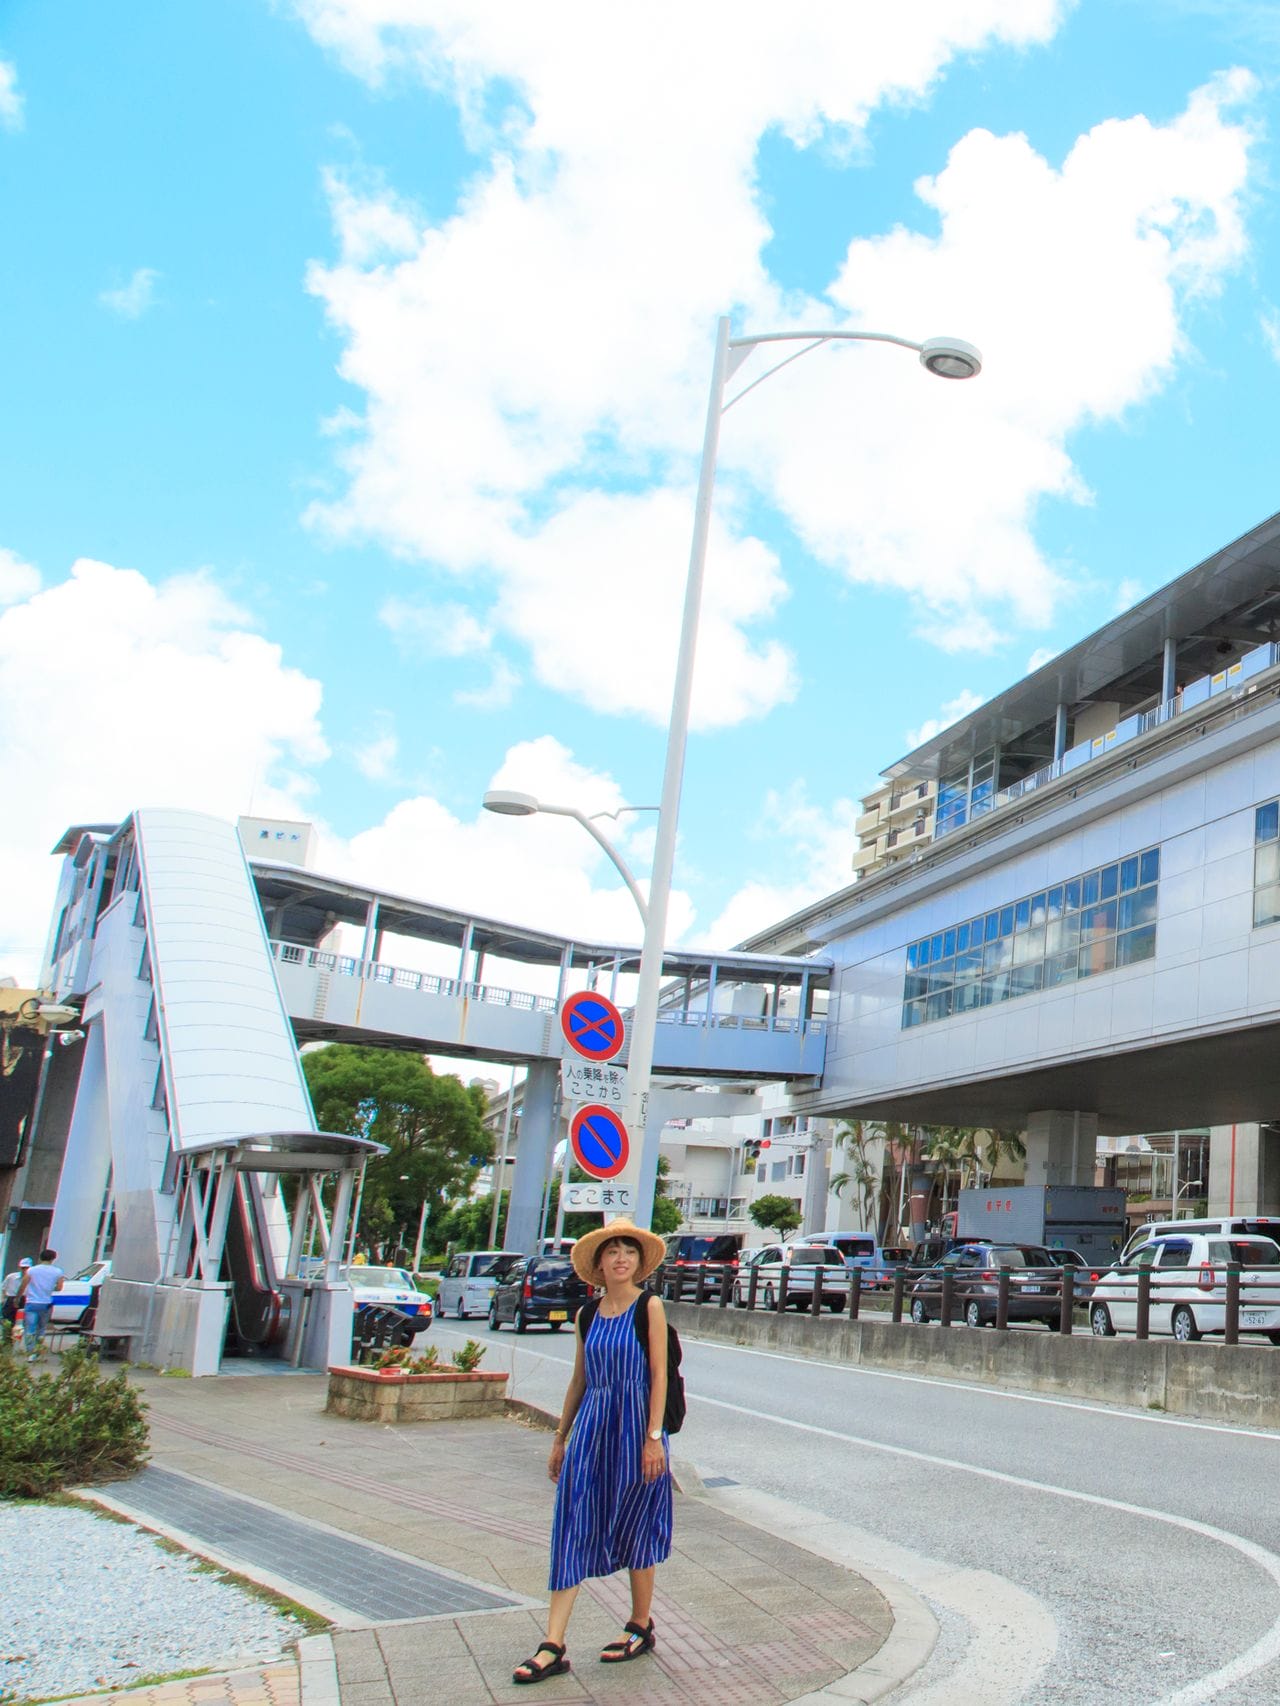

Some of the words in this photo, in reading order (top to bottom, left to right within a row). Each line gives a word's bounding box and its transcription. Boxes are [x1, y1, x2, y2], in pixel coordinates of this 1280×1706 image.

[571, 1081, 621, 1100] ここから
[569, 1189, 629, 1207] ここまで
